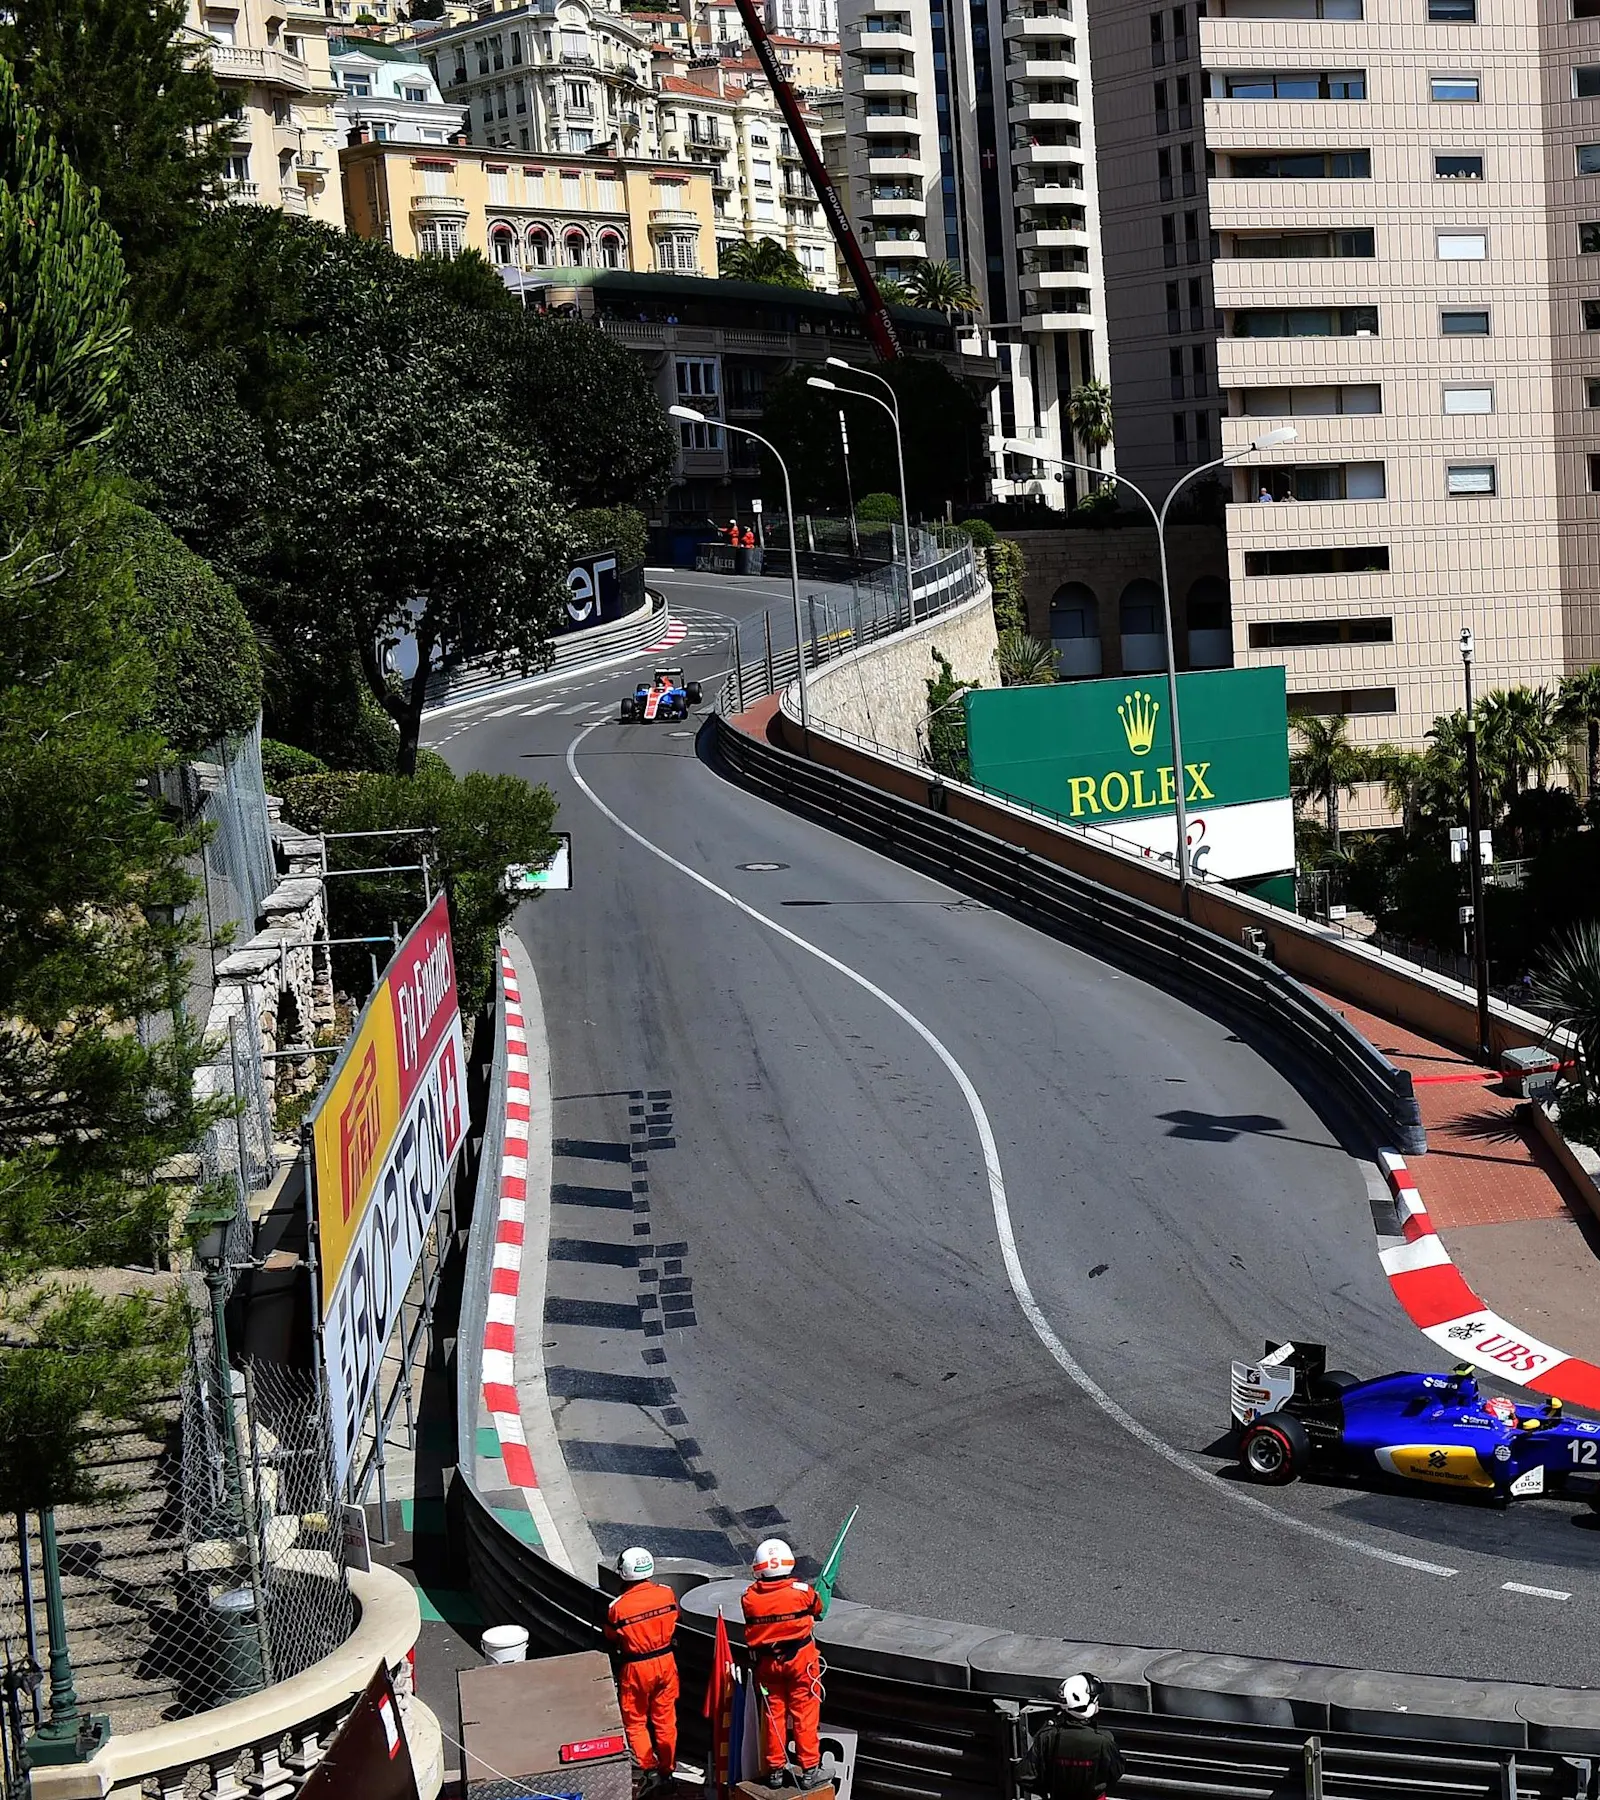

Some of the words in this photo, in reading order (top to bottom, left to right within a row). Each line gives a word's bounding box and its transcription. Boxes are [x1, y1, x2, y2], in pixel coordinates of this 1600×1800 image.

[762, 40, 784, 82] PIOVANO
[825, 186, 849, 231] PIOVANO
[1067, 762, 1215, 817] ROLEX
[398, 982, 418, 1071] Fly
[413, 930, 451, 1041] Emirates
[340, 1040, 381, 1227] PIRELLI
[351, 1060, 449, 1418] BIOPTRON
[1475, 1333, 1548, 1371] UBS
[1567, 1439, 1598, 1465] 12
